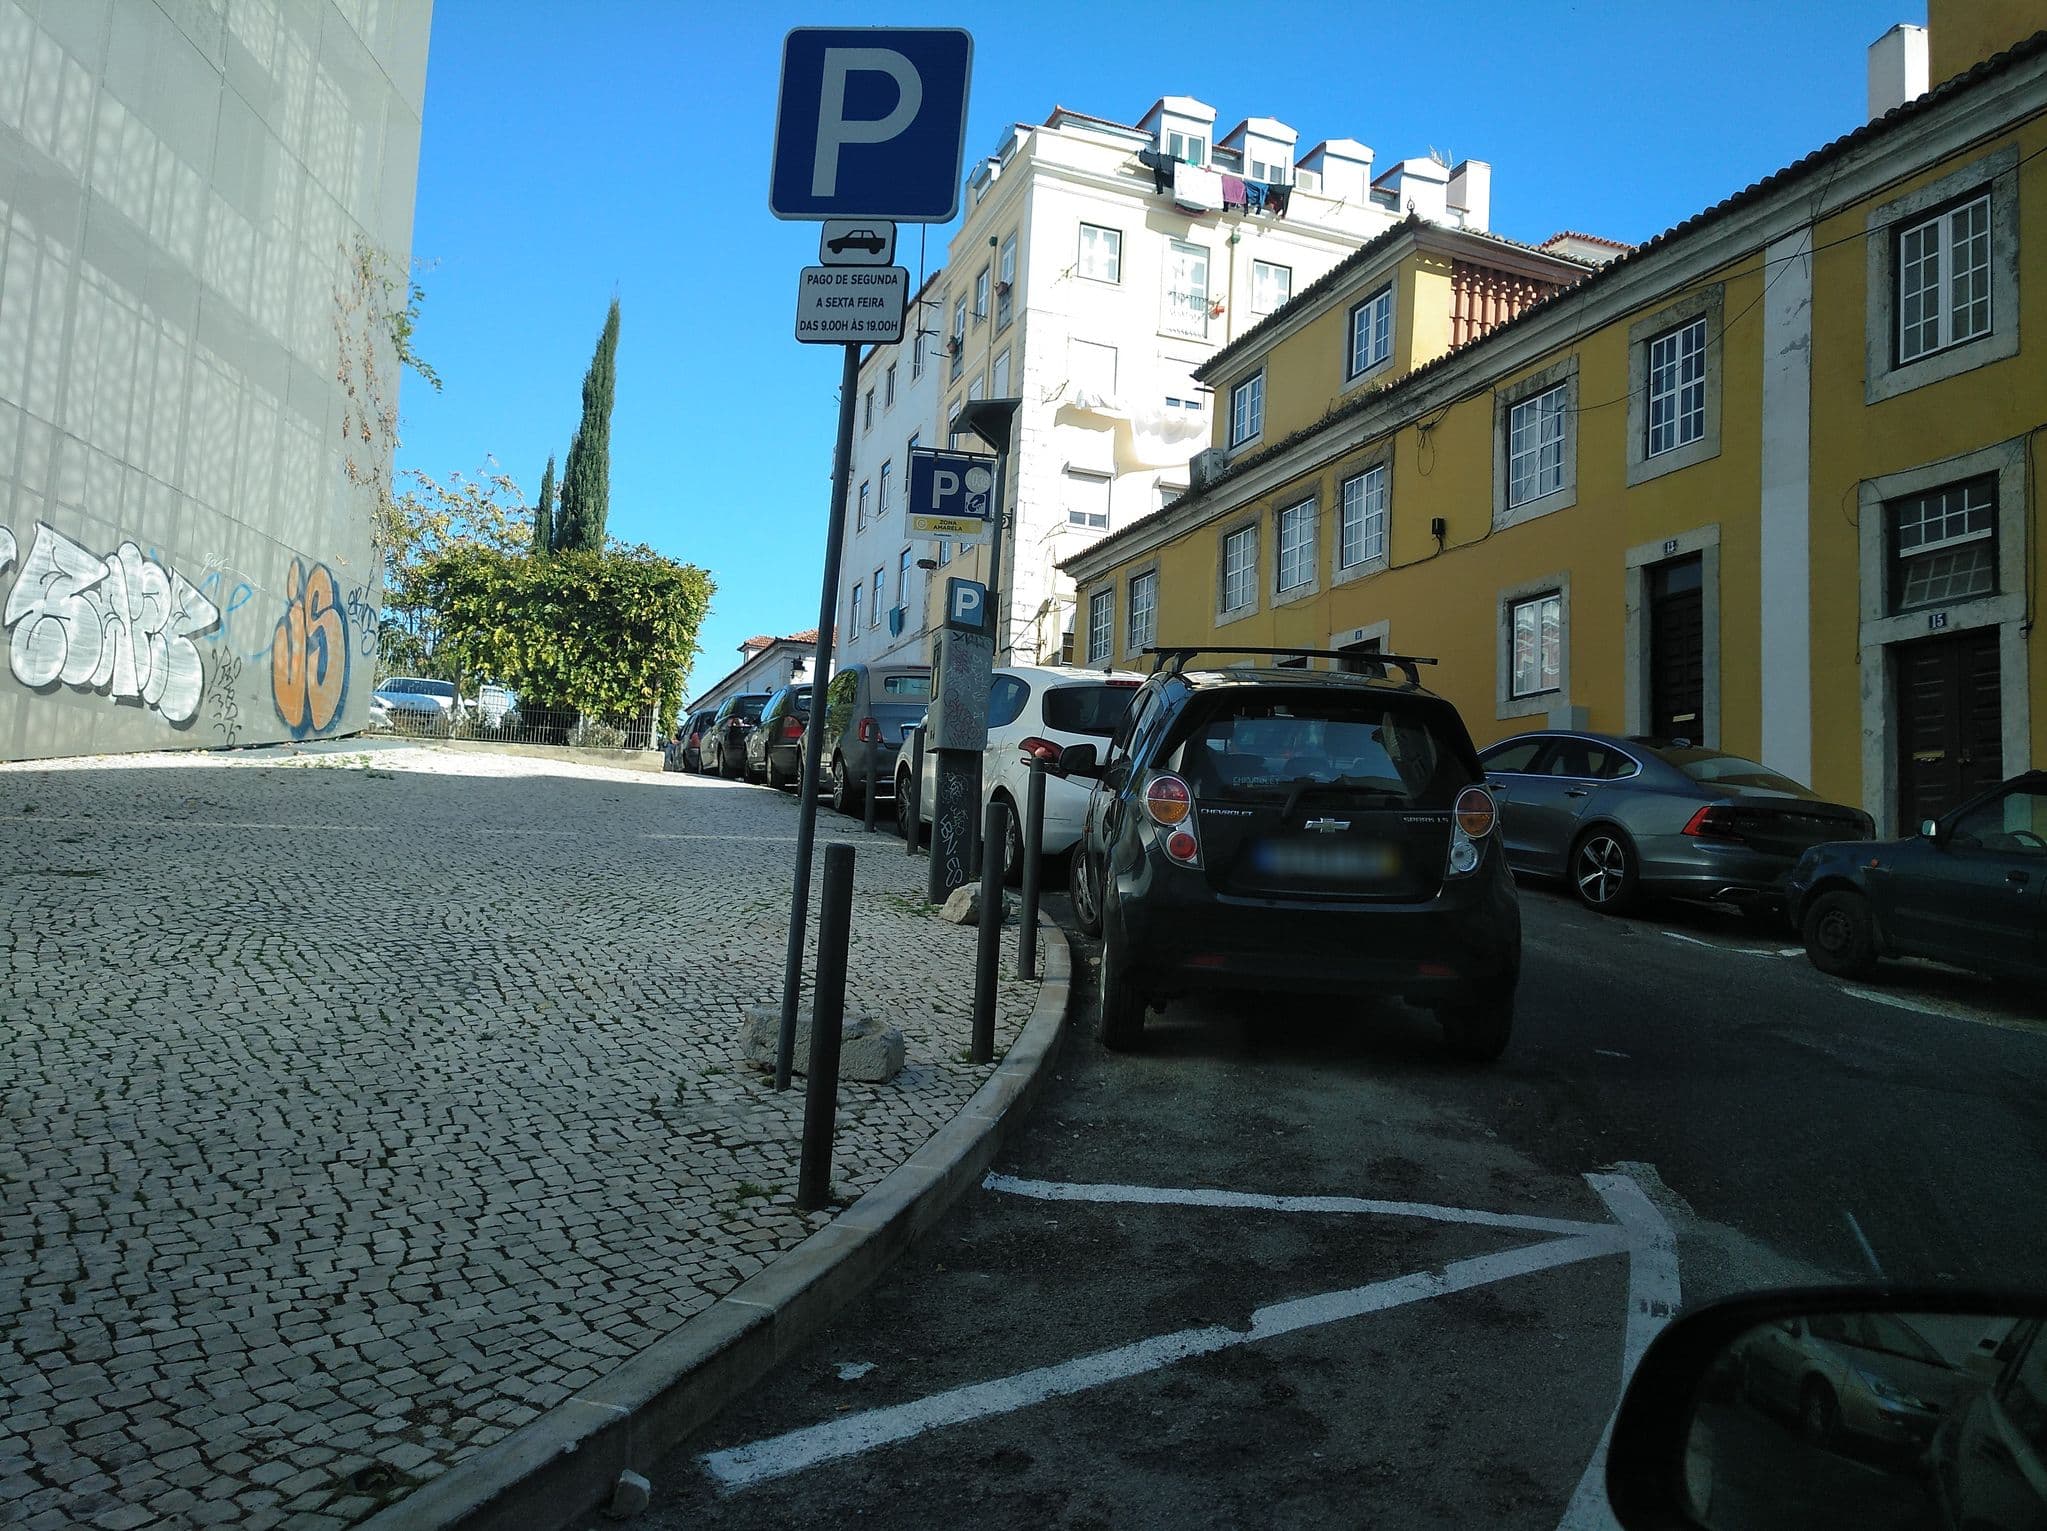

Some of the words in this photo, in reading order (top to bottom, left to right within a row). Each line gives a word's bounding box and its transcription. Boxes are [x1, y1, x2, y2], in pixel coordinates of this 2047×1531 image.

[811, 48, 922, 197] P
[807, 274, 833, 285] PAGO
[835, 274, 848, 285] DE
[850, 274, 898, 285] SEGUNDA
[816, 297, 823, 308] A
[825, 297, 855, 308] SEXTA
[857, 297, 884, 308] FEIRA
[799, 320, 819, 331] DAS
[821, 320, 848, 331] 9.00H
[850, 318, 864, 331] ÀS
[866, 320, 898, 331] 19.00H
[931, 470, 960, 509] P
[933, 524, 963, 532] AMARELA
[955, 587, 980, 617] P
[1932, 614, 1944, 628] 15
[1200, 808, 1254, 816] CHEVROLET
